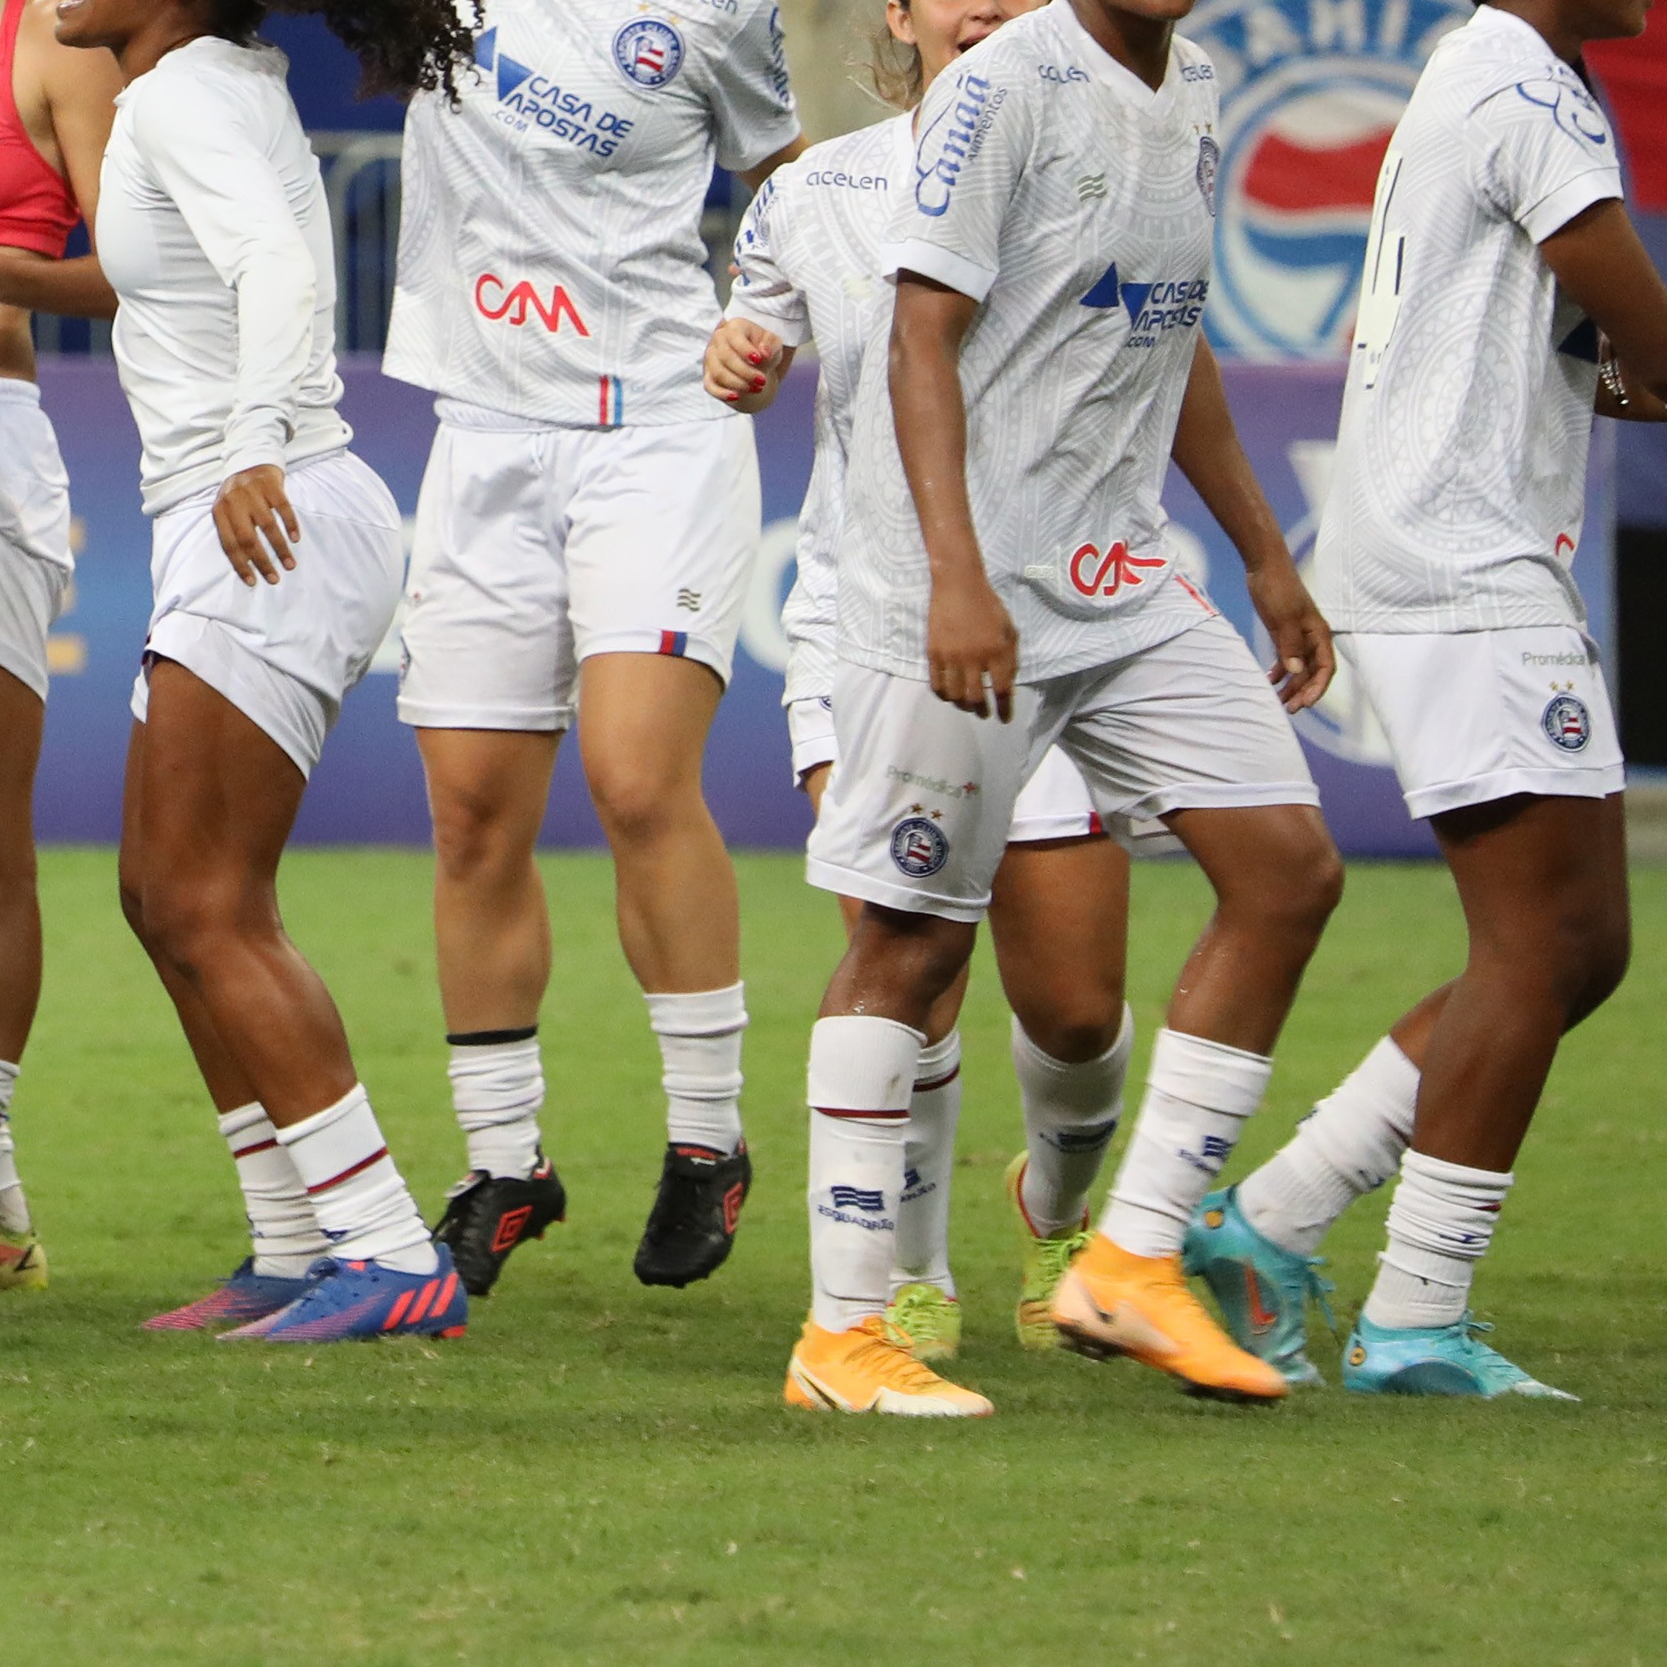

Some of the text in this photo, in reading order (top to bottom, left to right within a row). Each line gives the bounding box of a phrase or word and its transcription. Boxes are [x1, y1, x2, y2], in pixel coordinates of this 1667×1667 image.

[506, 93, 619, 158] APOSTAS
[528, 75, 635, 140] CASA DE
[968, 85, 1008, 163] Alimentos
[916, 70, 992, 218] Canaã
[806, 170, 888, 191] acelen
[1151, 282, 1191, 305] CAS
